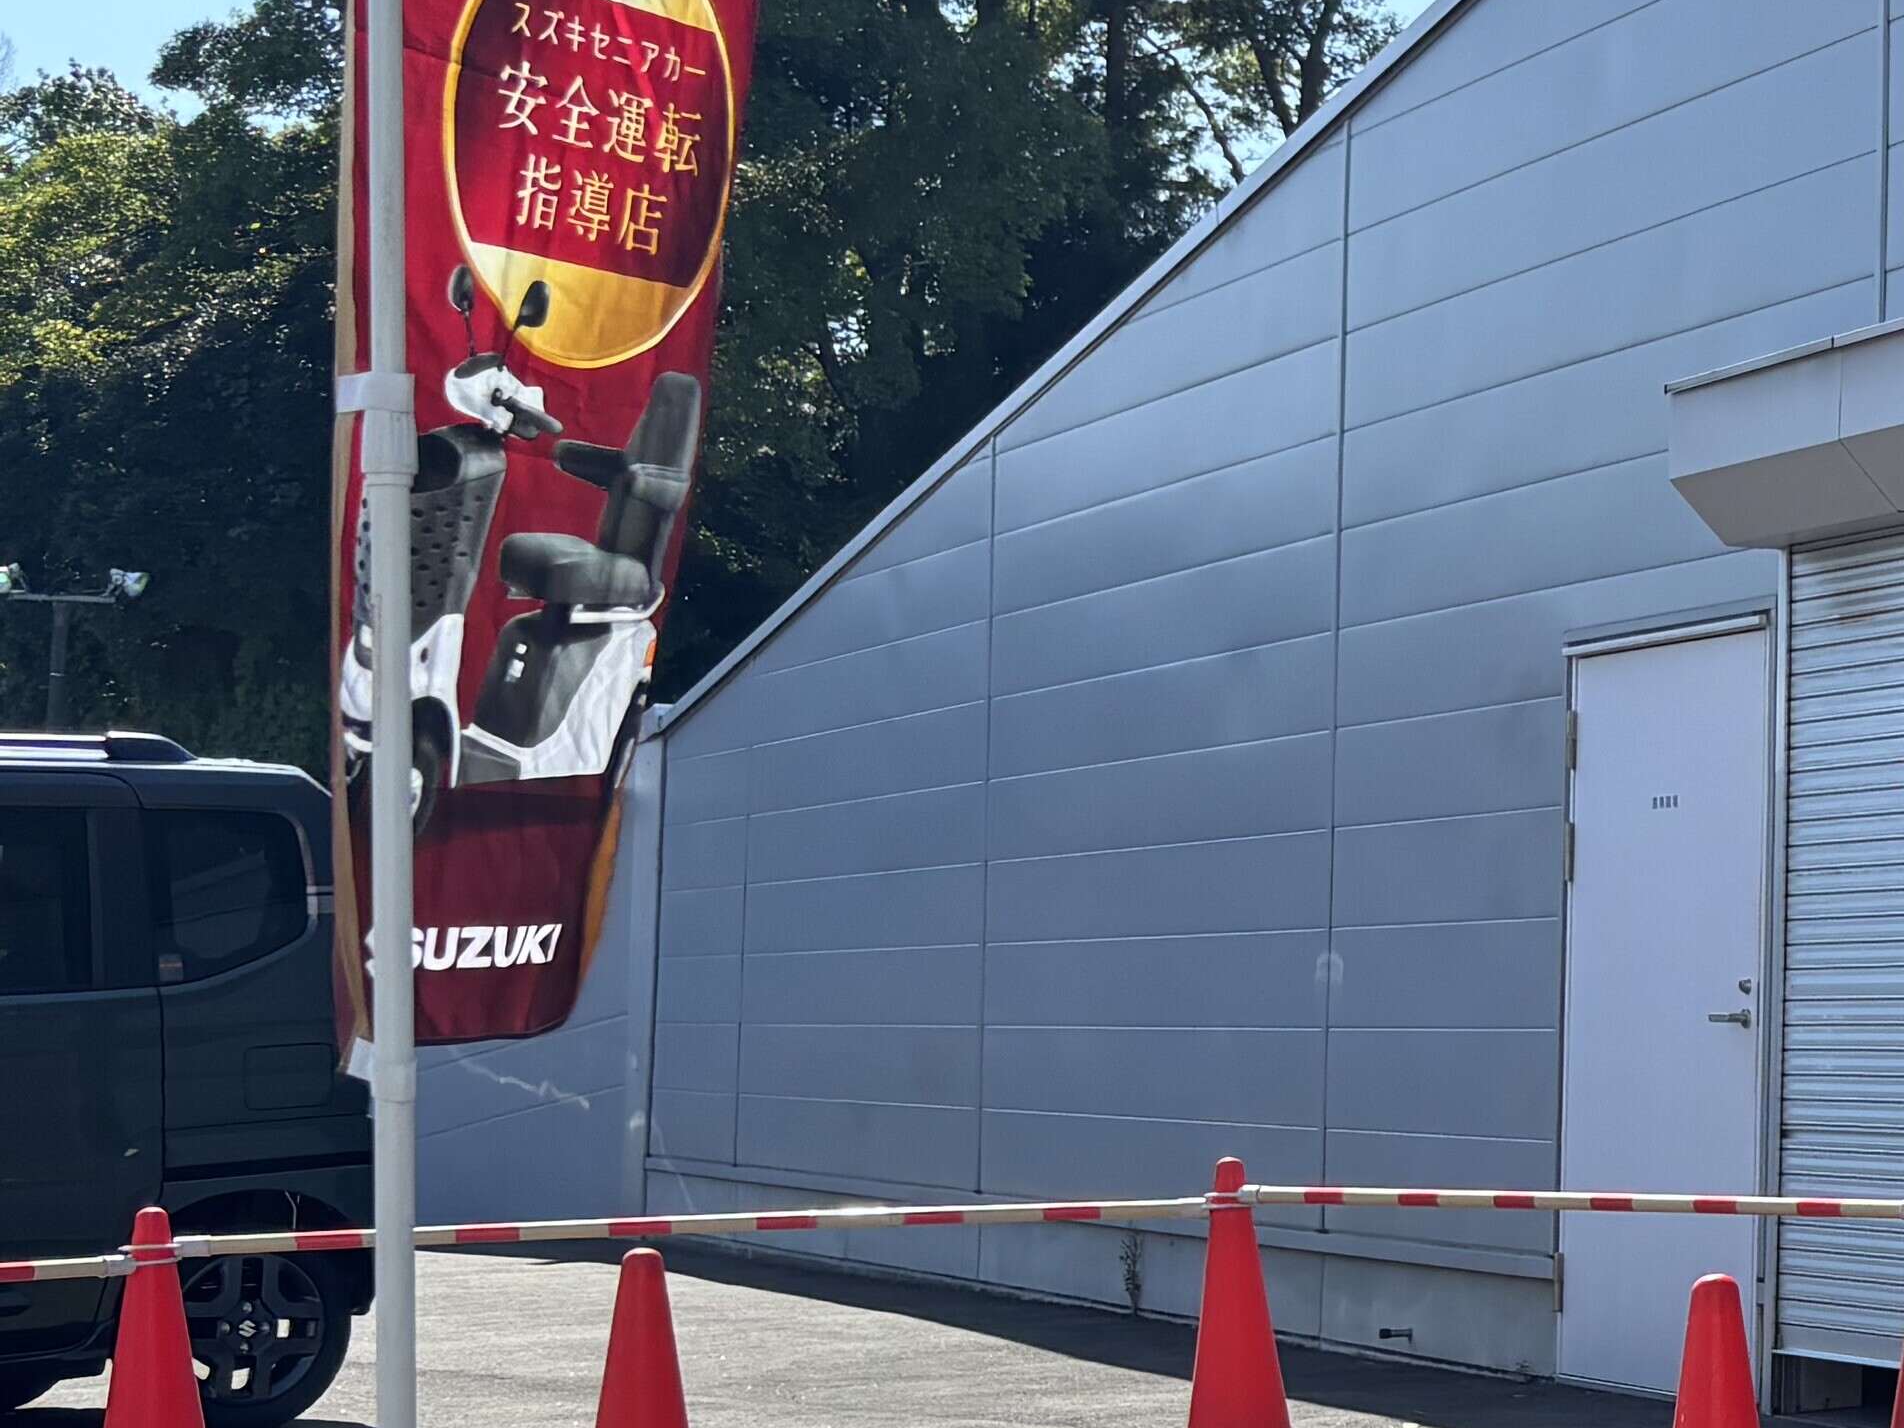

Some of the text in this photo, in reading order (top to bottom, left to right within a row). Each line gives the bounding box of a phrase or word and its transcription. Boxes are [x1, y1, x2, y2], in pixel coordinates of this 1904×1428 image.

[510, 0, 706, 82] スズキセニアカー
[497, 60, 703, 177] 安全運転
[515, 152, 669, 256] 指導店
[412, 923, 563, 971] UZUKI
